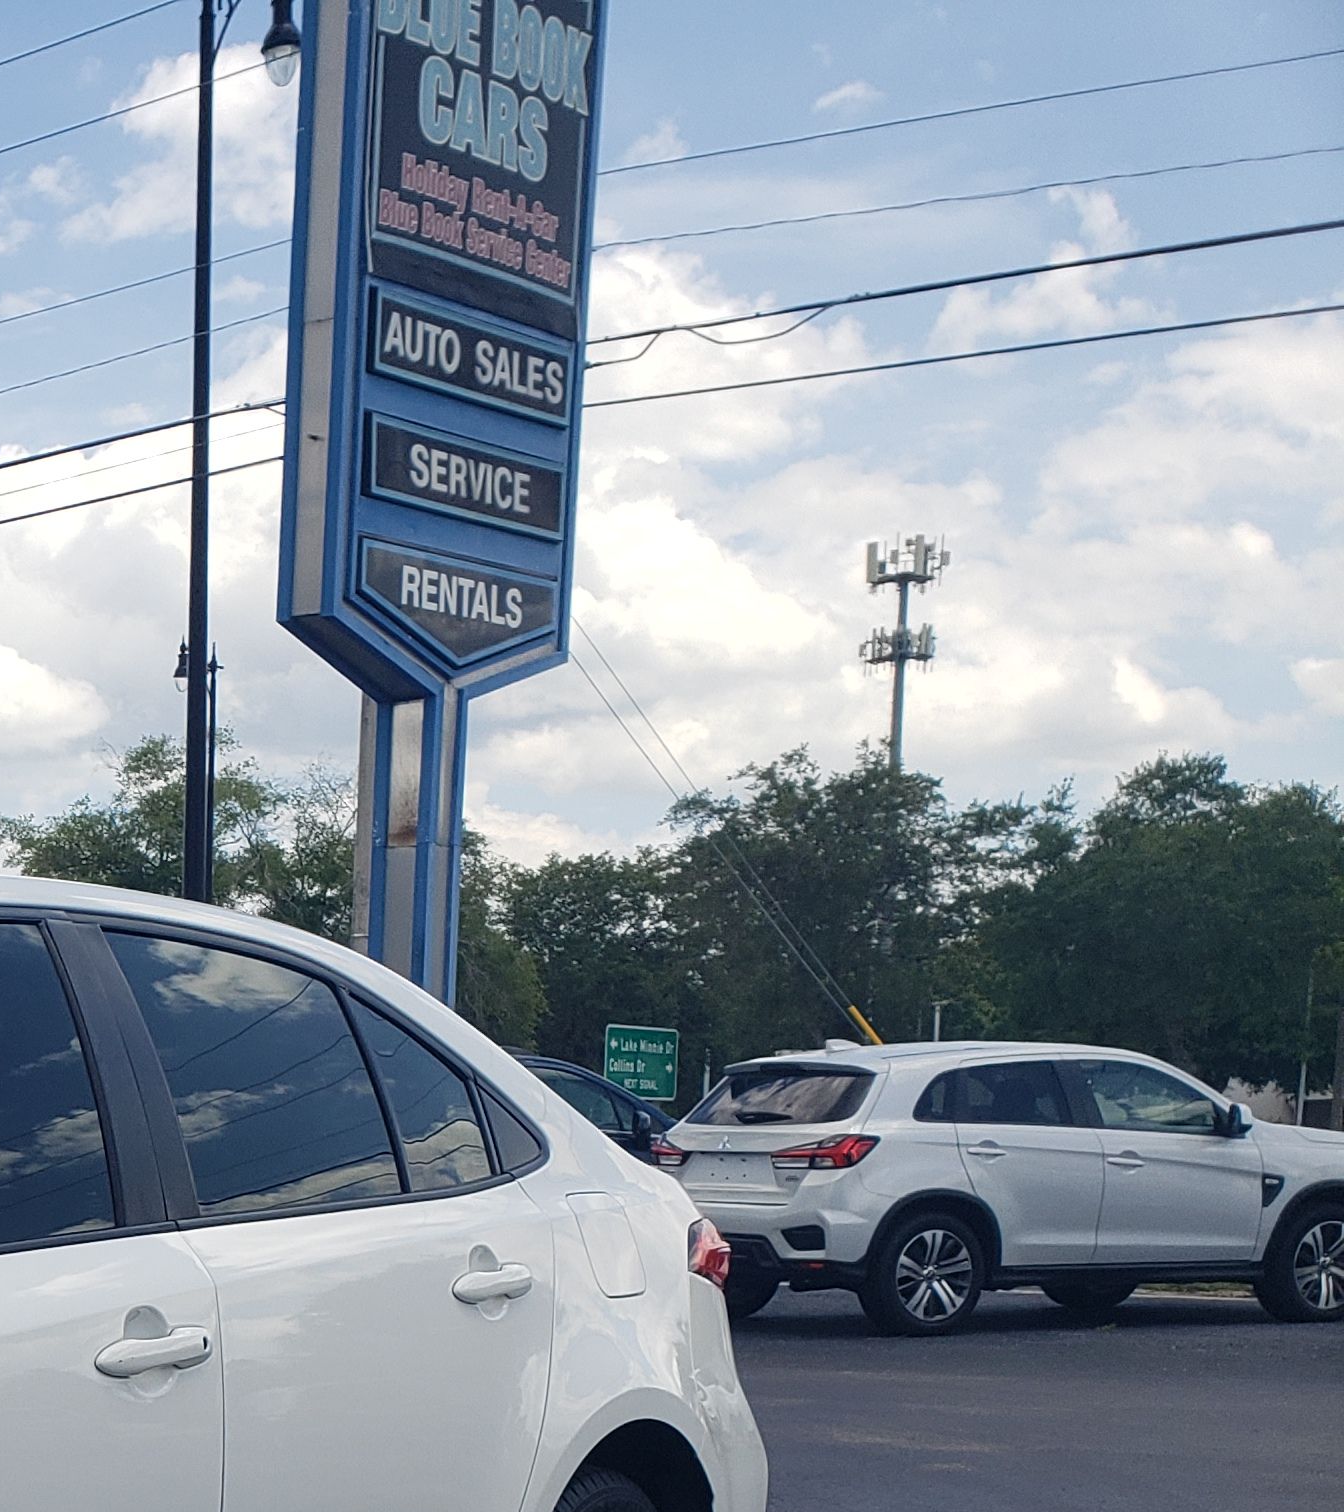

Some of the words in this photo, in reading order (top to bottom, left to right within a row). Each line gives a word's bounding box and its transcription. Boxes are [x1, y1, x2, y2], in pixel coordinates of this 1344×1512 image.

[492, 0, 593, 117] BOOK
[419, 55, 548, 182] CARS
[378, 187, 419, 234] Blue
[420, 201, 465, 249] Book
[466, 217, 523, 270] Service
[525, 238, 571, 289] Center
[401, 152, 470, 215] Holiday
[471, 176, 560, 242] Rent-A-Car
[383, 311, 461, 375] AUTO
[474, 339, 564, 405] SALES
[410, 443, 531, 514] SERVICE
[400, 564, 523, 629] RENTALS
[609, 1057, 634, 1073] Collins
[636, 1059, 646, 1073] Dr
[620, 1038, 638, 1052] Lake
[665, 1041, 674, 1054] Dr
